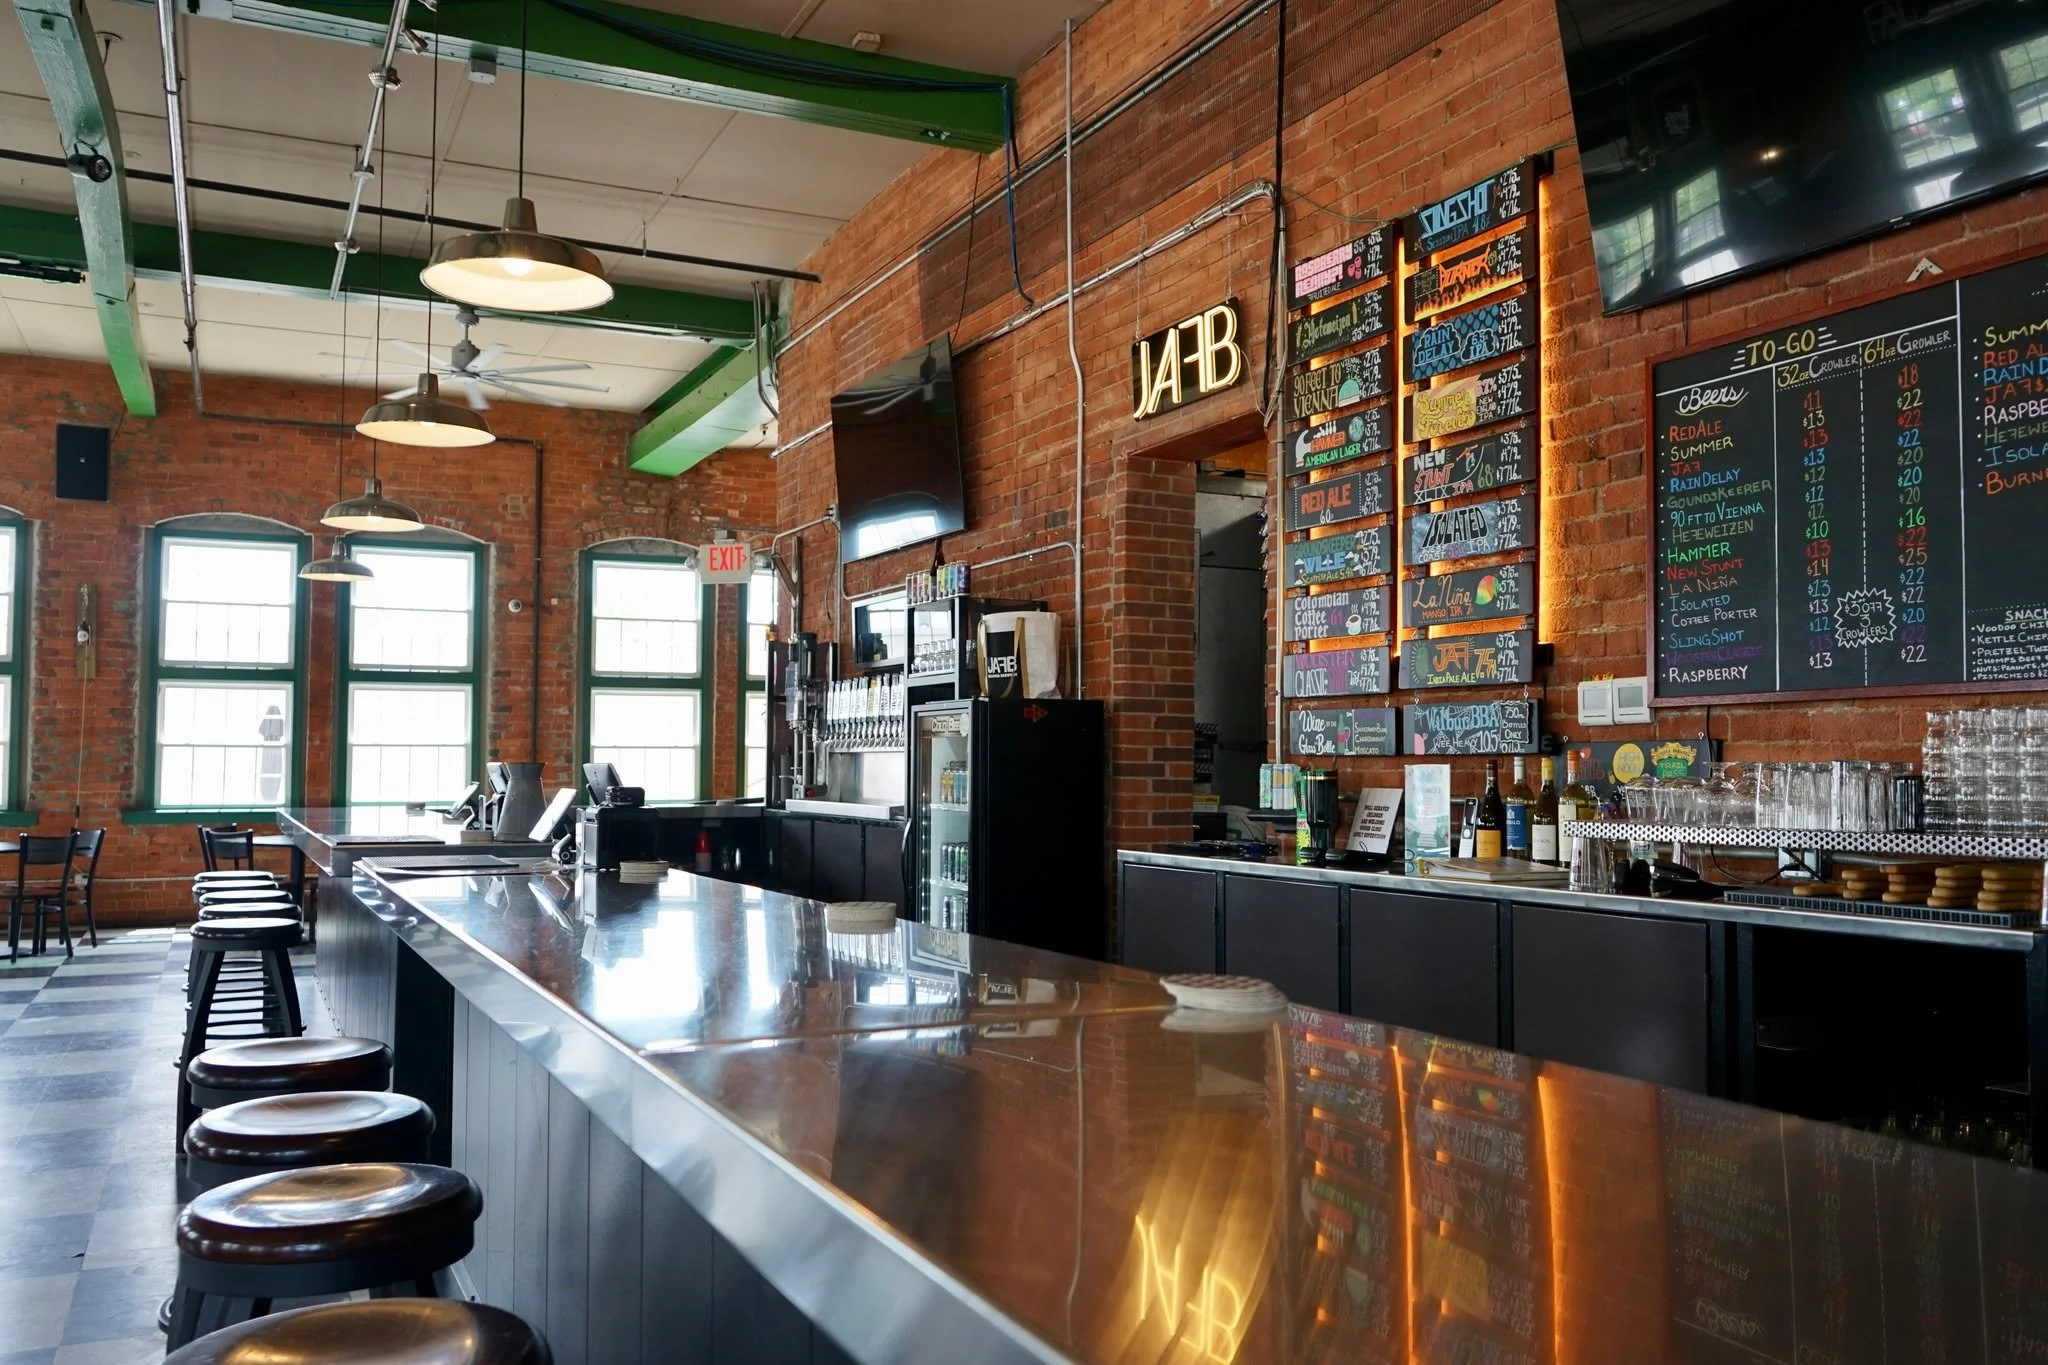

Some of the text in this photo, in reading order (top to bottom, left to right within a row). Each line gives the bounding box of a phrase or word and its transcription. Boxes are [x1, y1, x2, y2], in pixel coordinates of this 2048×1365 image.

[1424, 326, 1451, 349] RAIN
[1745, 329, 1816, 366] TO-GO
[1897, 329, 1951, 354] GROWLER
[1418, 341, 1455, 364] DELAY
[1470, 343, 1490, 360] IPA
[1984, 348, 2018, 368] RED
[1133, 305, 1241, 419] JAFB
[1808, 354, 1859, 378] CROWLER
[1984, 360, 2034, 387] RAIN
[1679, 385, 1744, 414] Beers
[1897, 388, 1923, 411] $22
[1803, 410, 1825, 430] $13
[1670, 436, 1734, 461] SUMMER
[1897, 429, 1921, 448] $22
[1305, 443, 1361, 468] AMERICAN LAGER
[1414, 448, 1446, 471] NEW
[1804, 447, 1826, 467] $13
[1897, 447, 1923, 466] $20
[1414, 462, 1455, 492] STUNT
[1670, 468, 1740, 493] RAIN DELAY
[1804, 467, 1826, 484] $12
[1897, 466, 1922, 487] $20
[1452, 480, 1474, 496] IPA
[1805, 485, 1824, 503] $12
[1301, 489, 1326, 515] RED
[1327, 483, 1352, 508] ALE
[1671, 501, 1765, 527] 90 FT TO VIENNA
[1898, 506, 1926, 528] $16
[1422, 506, 1488, 548] ISOLATED
[1805, 520, 1829, 540] $10
[710, 546, 744, 571] EXIT
[1667, 542, 1731, 564] HAMMER
[1899, 547, 1928, 567] $25
[1666, 559, 1744, 581] NEW STUNT
[1807, 558, 1829, 577] $14
[1900, 567, 1924, 586] $22
[1669, 575, 1738, 596] LA NIÑA
[1808, 579, 1831, 598] $13
[1901, 586, 1924, 604] $22
[1669, 595, 1731, 612] ISOLATED
[1809, 599, 1829, 615] $13
[1714, 607, 1758, 621] PORTER
[1902, 608, 1925, 624] $20
[1809, 616, 1831, 633] $12
[1840, 625, 1888, 640] CROWLERS
[1976, 624, 2016, 633] VOODOO
[1977, 635, 2016, 644] KETTLE
[1809, 652, 1833, 669] $13
[1901, 645, 1927, 663] $22
[1977, 647, 2026, 657] PRETZEL
[1445, 671, 1460, 683] PALE
[1460, 671, 1476, 683] ALE
[1669, 665, 1748, 683] RASPBERRY
[1299, 710, 1326, 732] Wine
[1471, 705, 1499, 728] BBA
[1433, 739, 1450, 748] WEE
[1505, 730, 1522, 739] ONLY
[1660, 762, 1687, 770] TRAIL
